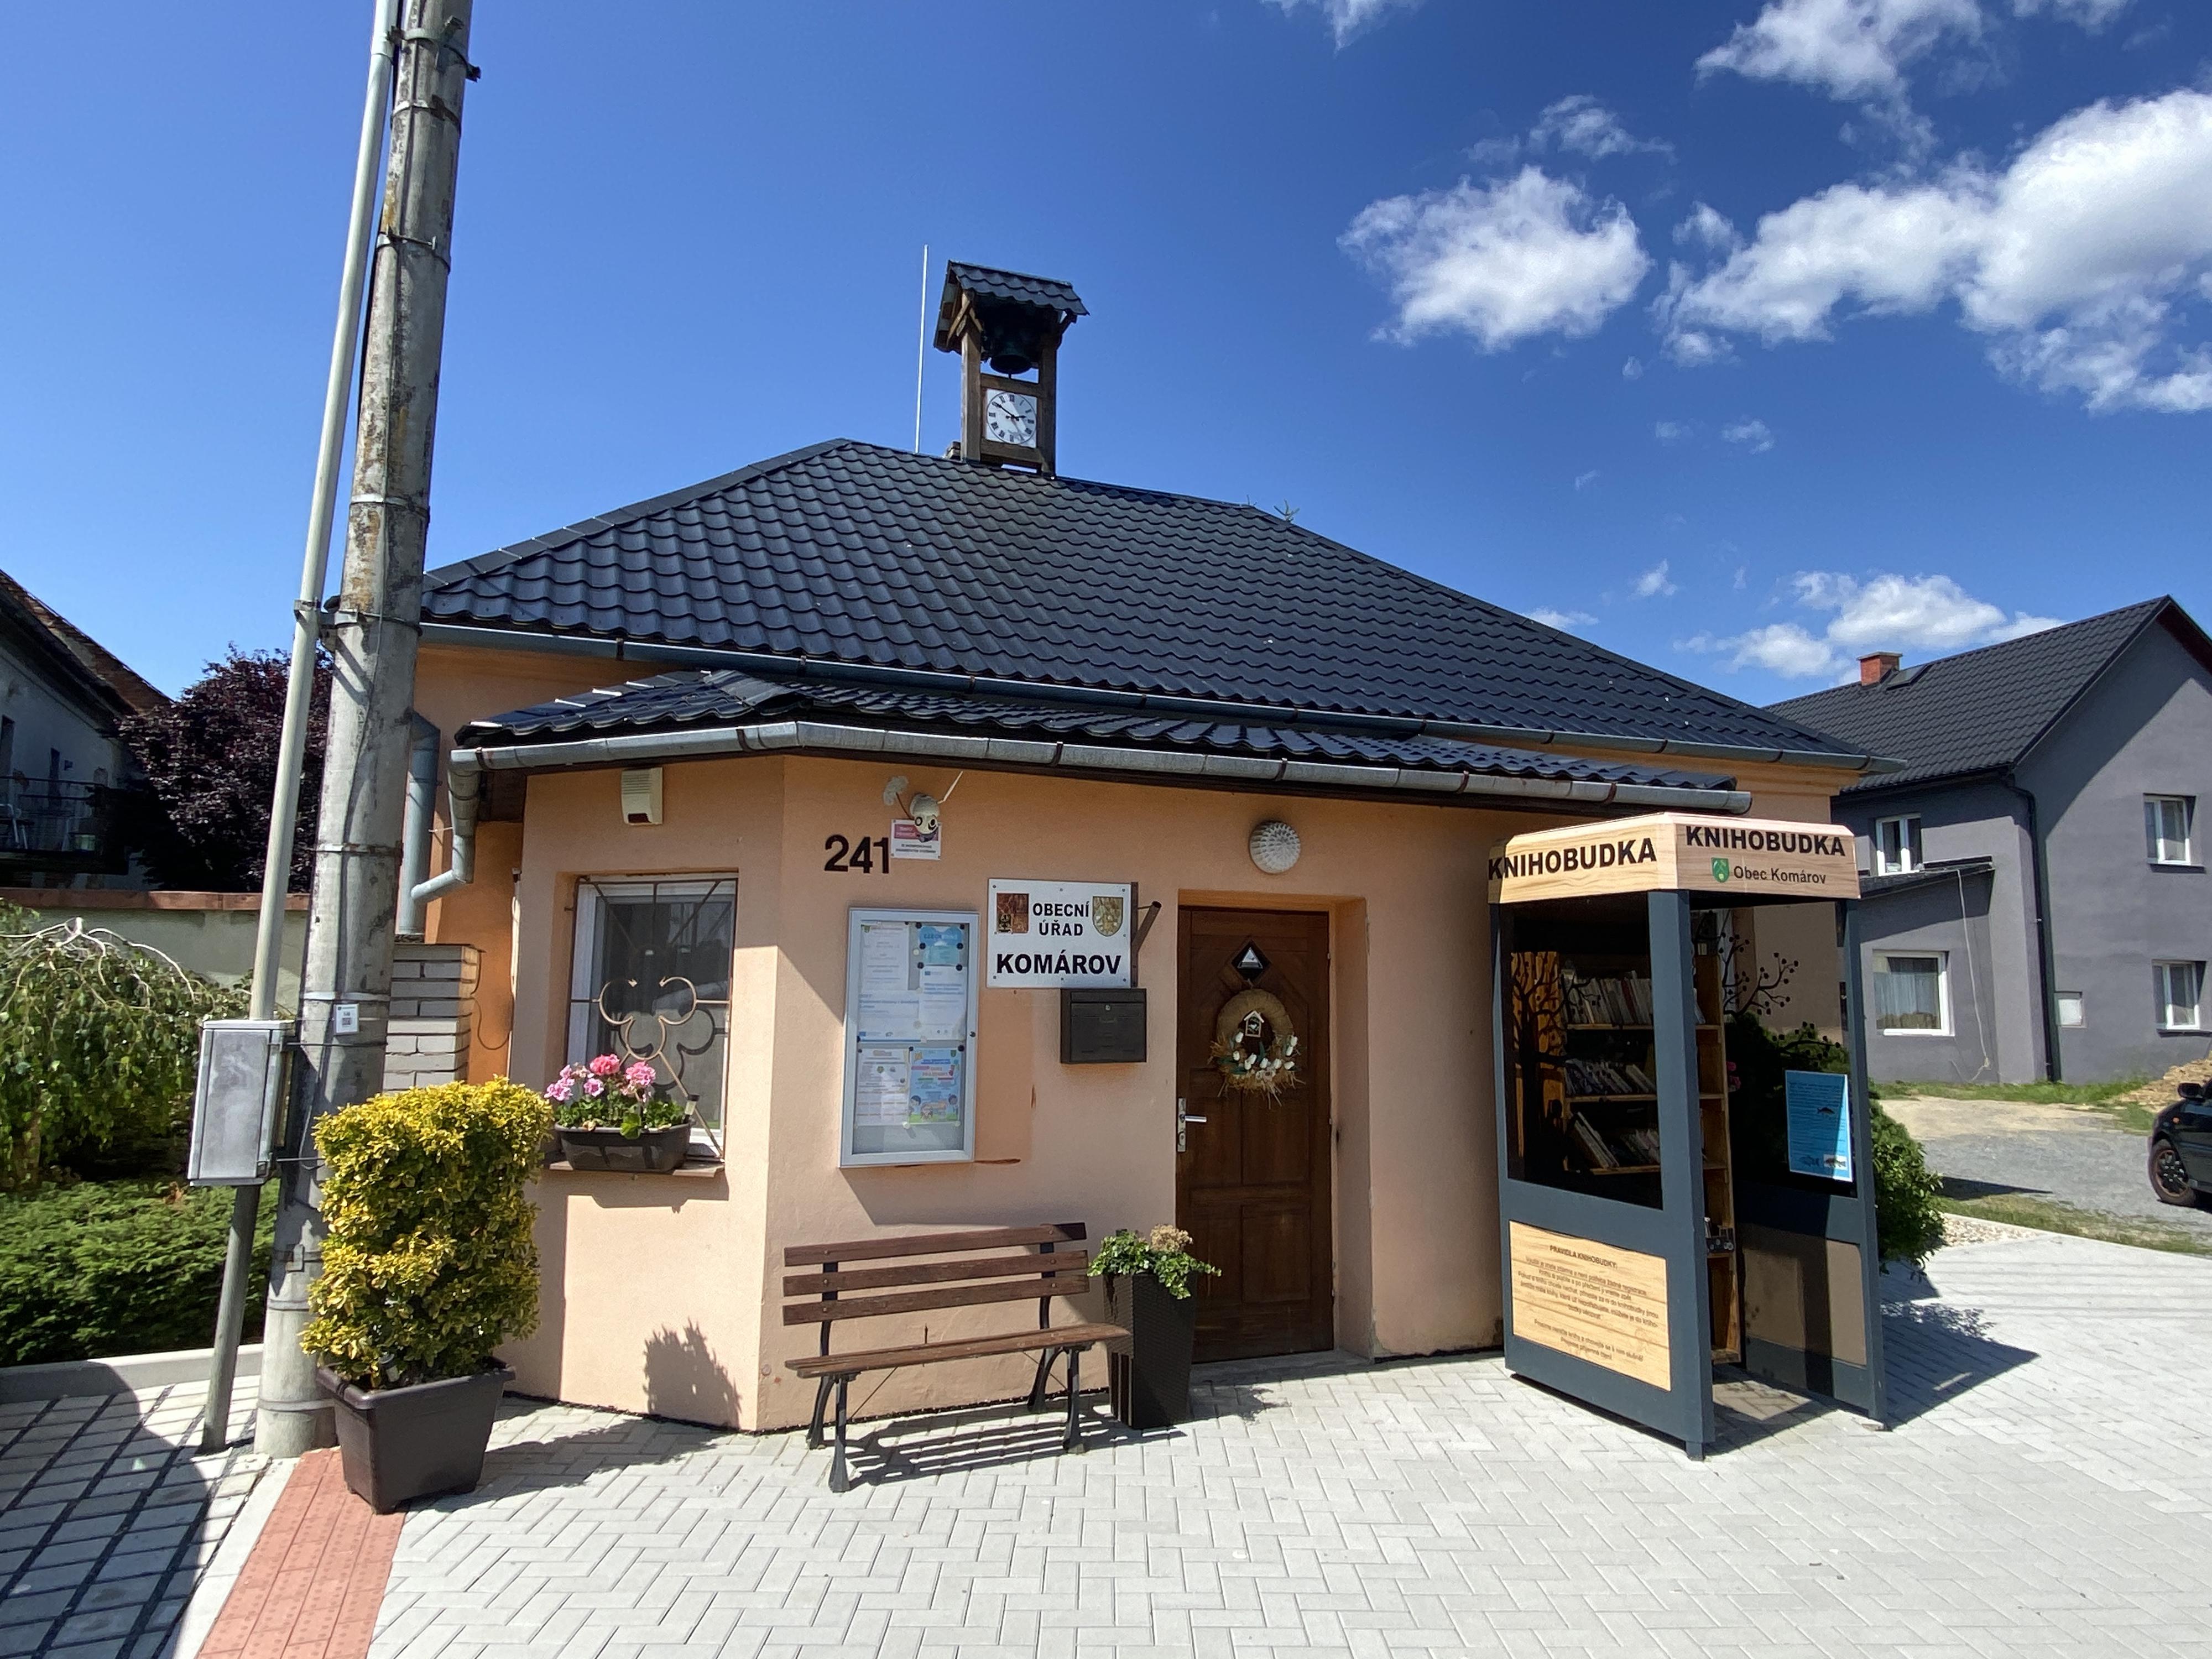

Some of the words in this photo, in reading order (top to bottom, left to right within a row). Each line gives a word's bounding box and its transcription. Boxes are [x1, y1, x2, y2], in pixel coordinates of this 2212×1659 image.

[1686, 826, 1846, 857] KNIHOBUDKA
[824, 834, 889, 874] 241
[1488, 838, 1657, 880] KNIHOBUDKA
[1734, 865, 1767, 880] Obec
[1771, 868, 1827, 885] Komárov
[1032, 901, 1089, 917] OBECNÍ
[1039, 920, 1083, 936] ÚŘAD
[997, 950, 1121, 974] KOMÁROV
